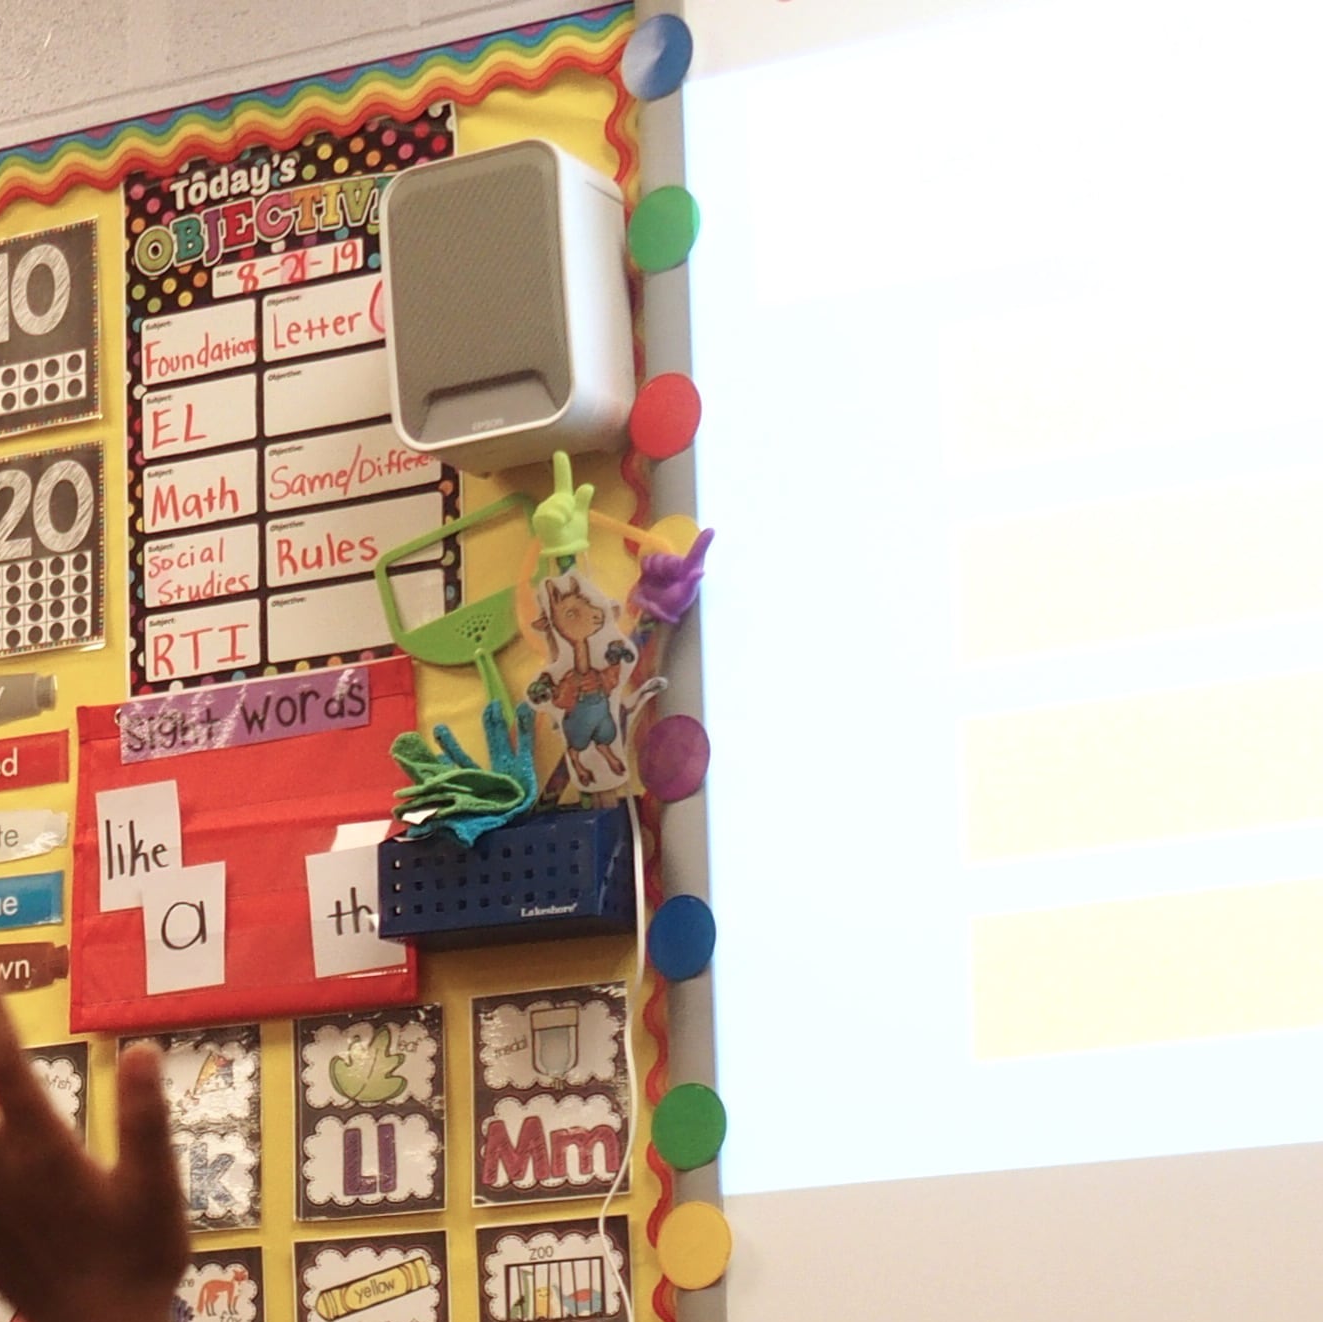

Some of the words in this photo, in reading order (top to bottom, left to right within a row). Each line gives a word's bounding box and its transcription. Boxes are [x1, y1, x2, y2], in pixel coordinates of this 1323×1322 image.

[169, 154, 297, 211] Today's
[273, 312, 362, 350] Letter
[152, 404, 206, 450] EL
[151, 476, 239, 527] Math
[148, 537, 224, 579] Social
[277, 533, 378, 577] Rules
[158, 570, 250, 605] Studies
[154, 624, 249, 676] RTI
[241, 682, 366, 734] words
[105, 820, 169, 880] like
[162, 900, 207, 950] a
[327, 887, 375, 935] th
[482, 1116, 620, 1185] Mm
[529, 1246, 554, 1260] zoo
[355, 1278, 396, 1302] yellow
